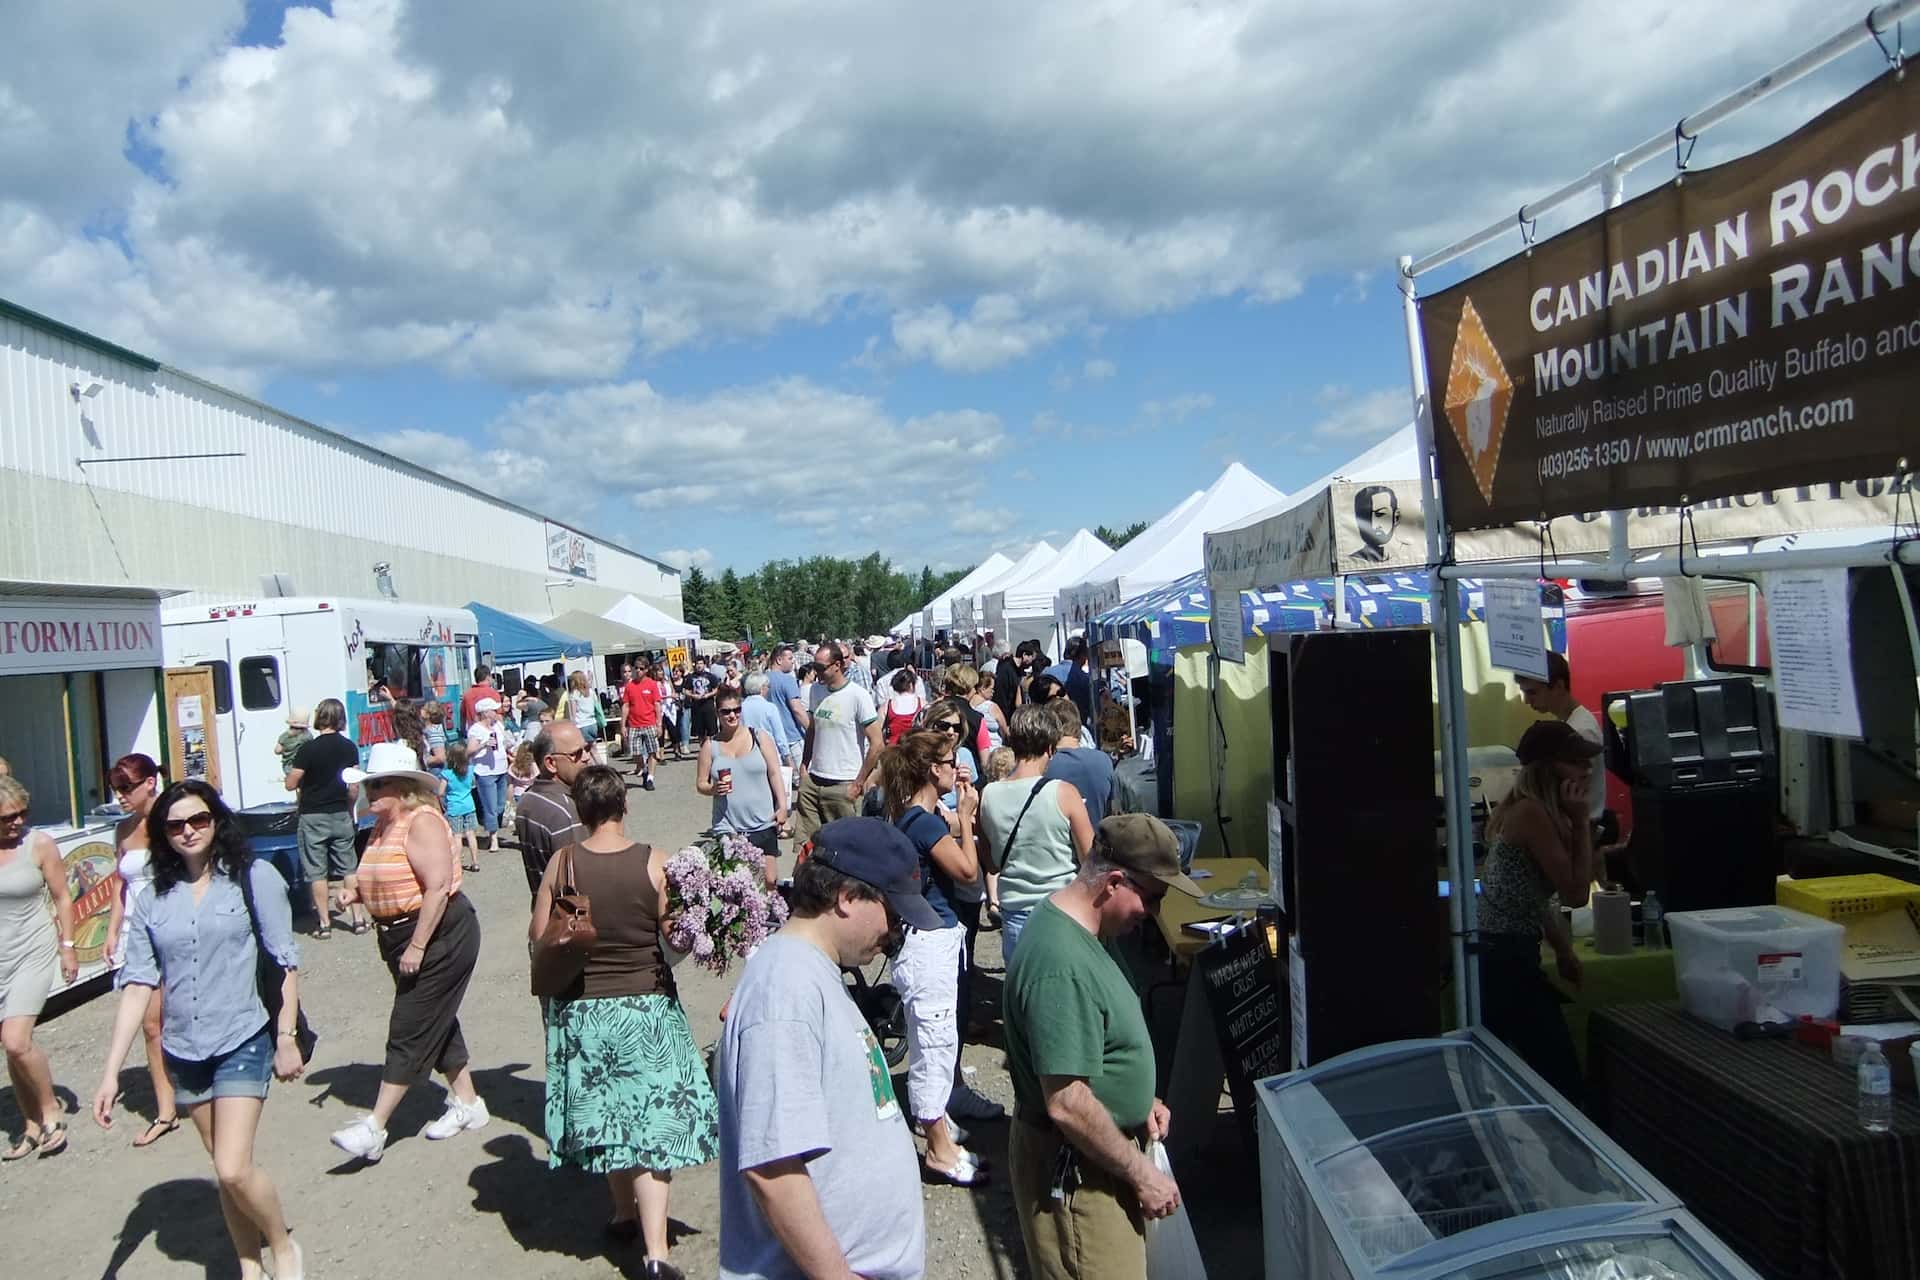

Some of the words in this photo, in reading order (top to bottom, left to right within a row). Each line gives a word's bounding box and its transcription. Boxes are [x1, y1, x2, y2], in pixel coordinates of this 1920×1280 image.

[1530, 211, 1749, 332] CANADIAN
[1533, 292, 1748, 397] MOUNTAIN
[1536, 404, 1590, 439] Naturally
[1593, 387, 1647, 425] Raised
[1653, 381, 1702, 412] Prime
[1708, 359, 1777, 398] Quality
[1785, 332, 1867, 378] Buffalo
[1537, 439, 1630, 486] (403)256-1350
[1646, 397, 1853, 459] www.crmranch.com
[0, 621, 152, 654] FORMATION
[1228, 1011, 1256, 1040] WHITE
